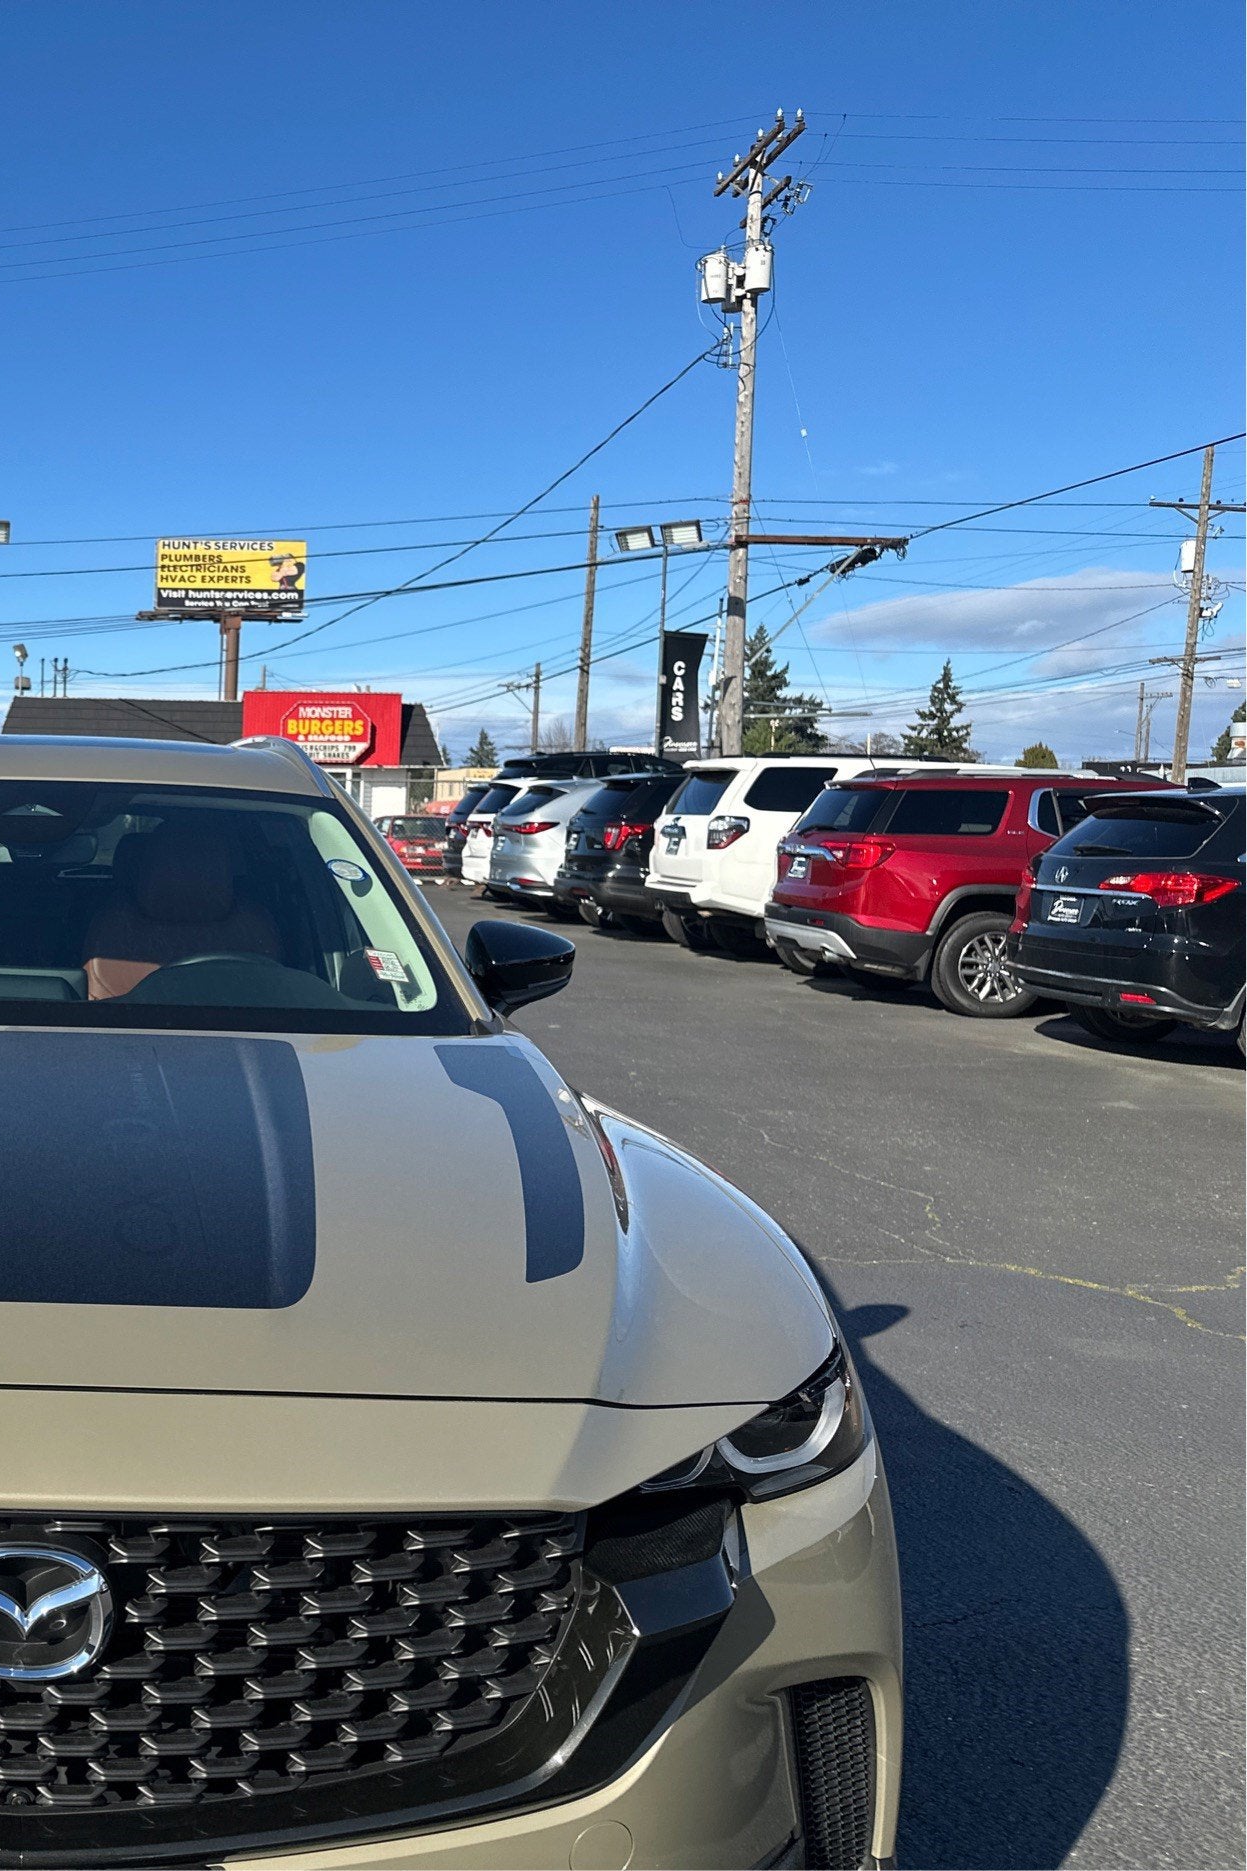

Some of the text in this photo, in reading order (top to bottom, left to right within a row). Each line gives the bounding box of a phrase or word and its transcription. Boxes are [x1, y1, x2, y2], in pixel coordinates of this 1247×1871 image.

[162, 541, 274, 551] HUNT'S SERVICES
[160, 554, 223, 563] PLUMBERS
[160, 563, 246, 573] ELECTRICIANS
[160, 575, 252, 584] HVAC EXPERTS
[160, 589, 185, 598] Visit
[671, 660, 686, 721] CARS
[298, 706, 352, 718] MONSTER
[287, 719, 364, 735] BURGERS
